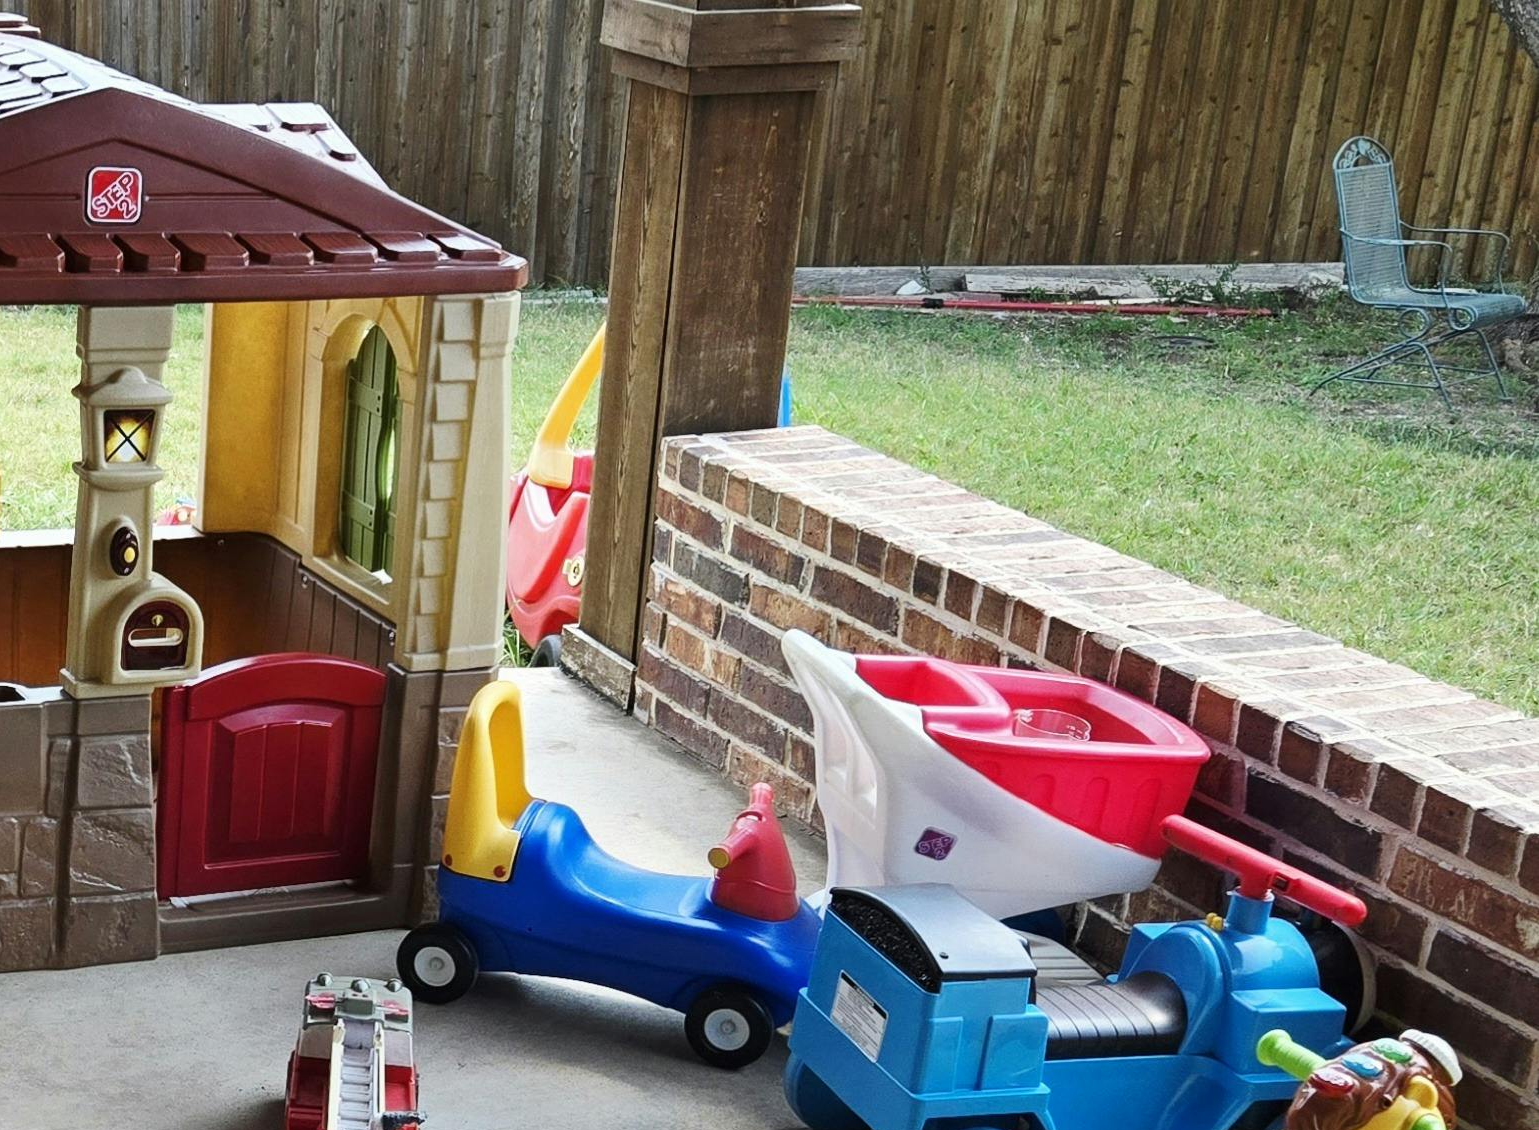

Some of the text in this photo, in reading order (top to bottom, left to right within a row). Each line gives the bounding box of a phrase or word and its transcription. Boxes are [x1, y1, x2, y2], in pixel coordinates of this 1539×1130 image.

[92, 172, 134, 218] STEP
[117, 197, 137, 219] 2
[918, 836, 952, 854] STEP
